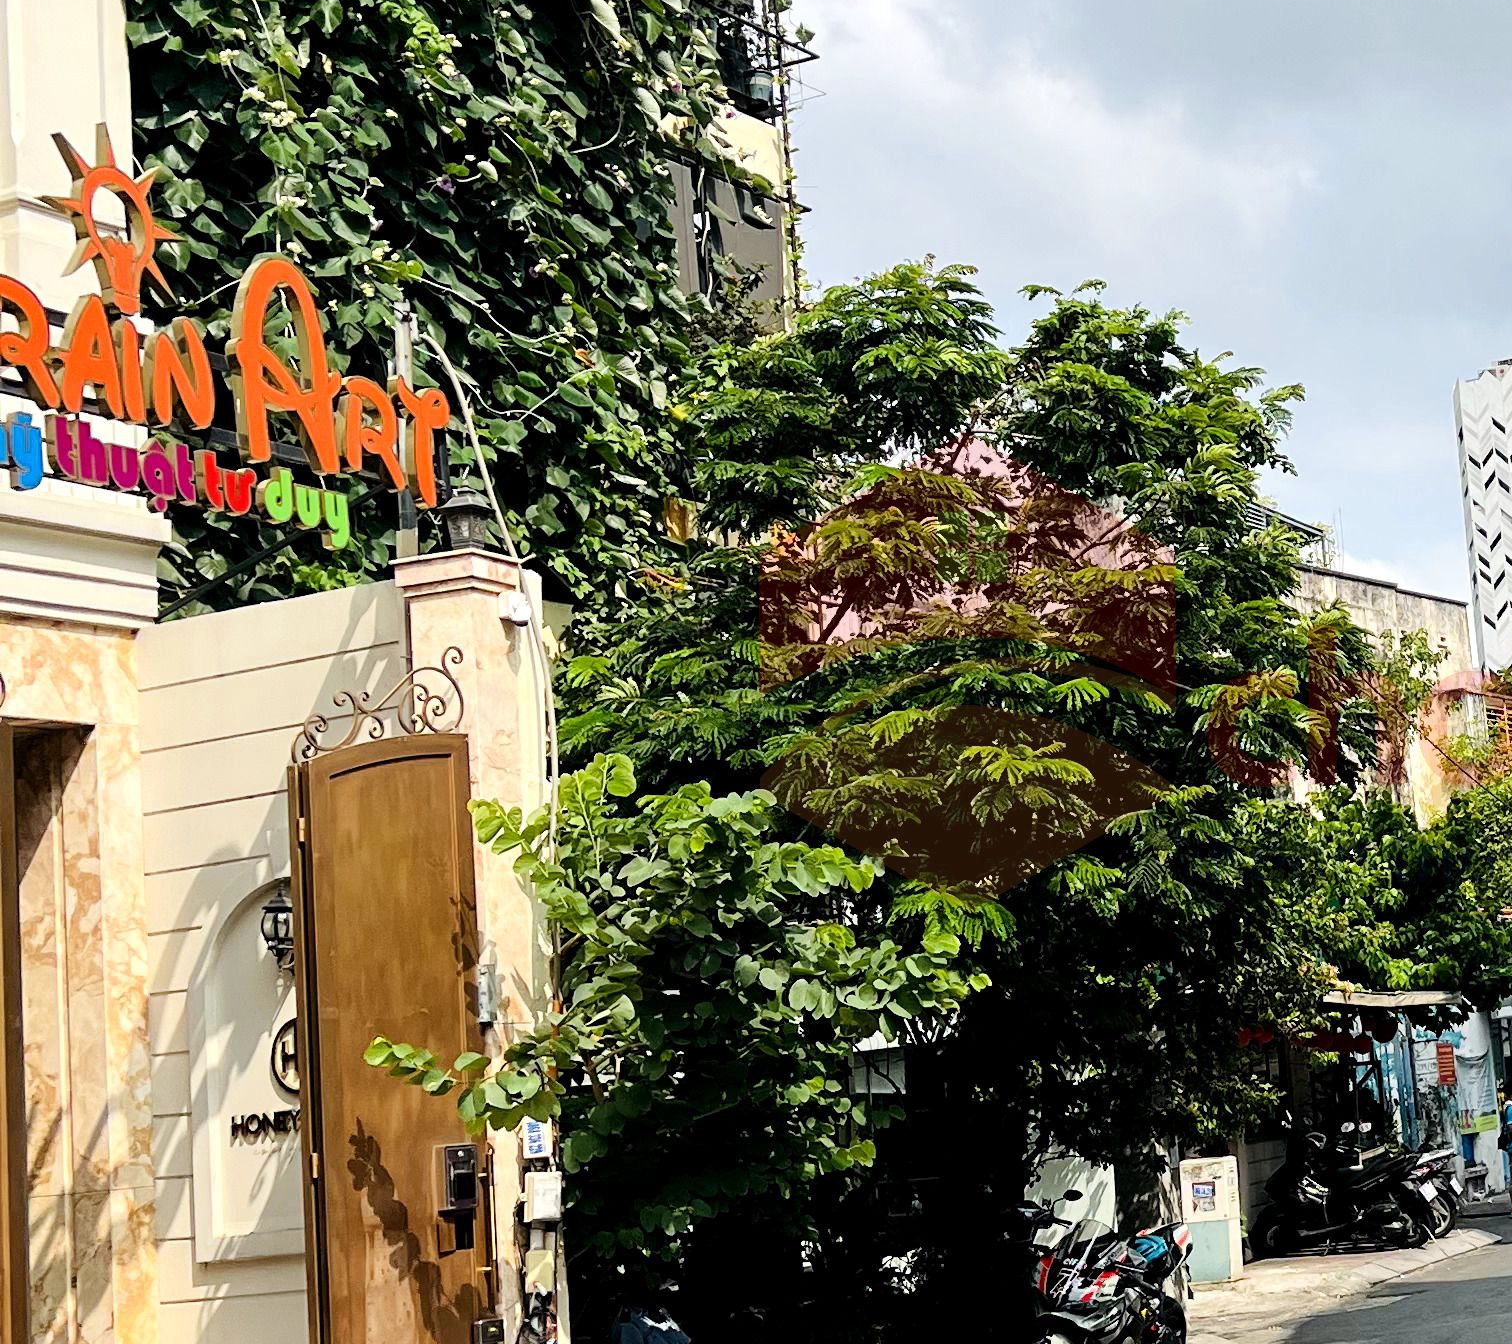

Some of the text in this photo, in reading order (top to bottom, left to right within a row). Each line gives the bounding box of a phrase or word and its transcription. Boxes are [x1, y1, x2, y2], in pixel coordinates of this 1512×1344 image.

[52, 414, 197, 513] thuật
[200, 450, 257, 516] tư
[261, 467, 350, 550] duy
